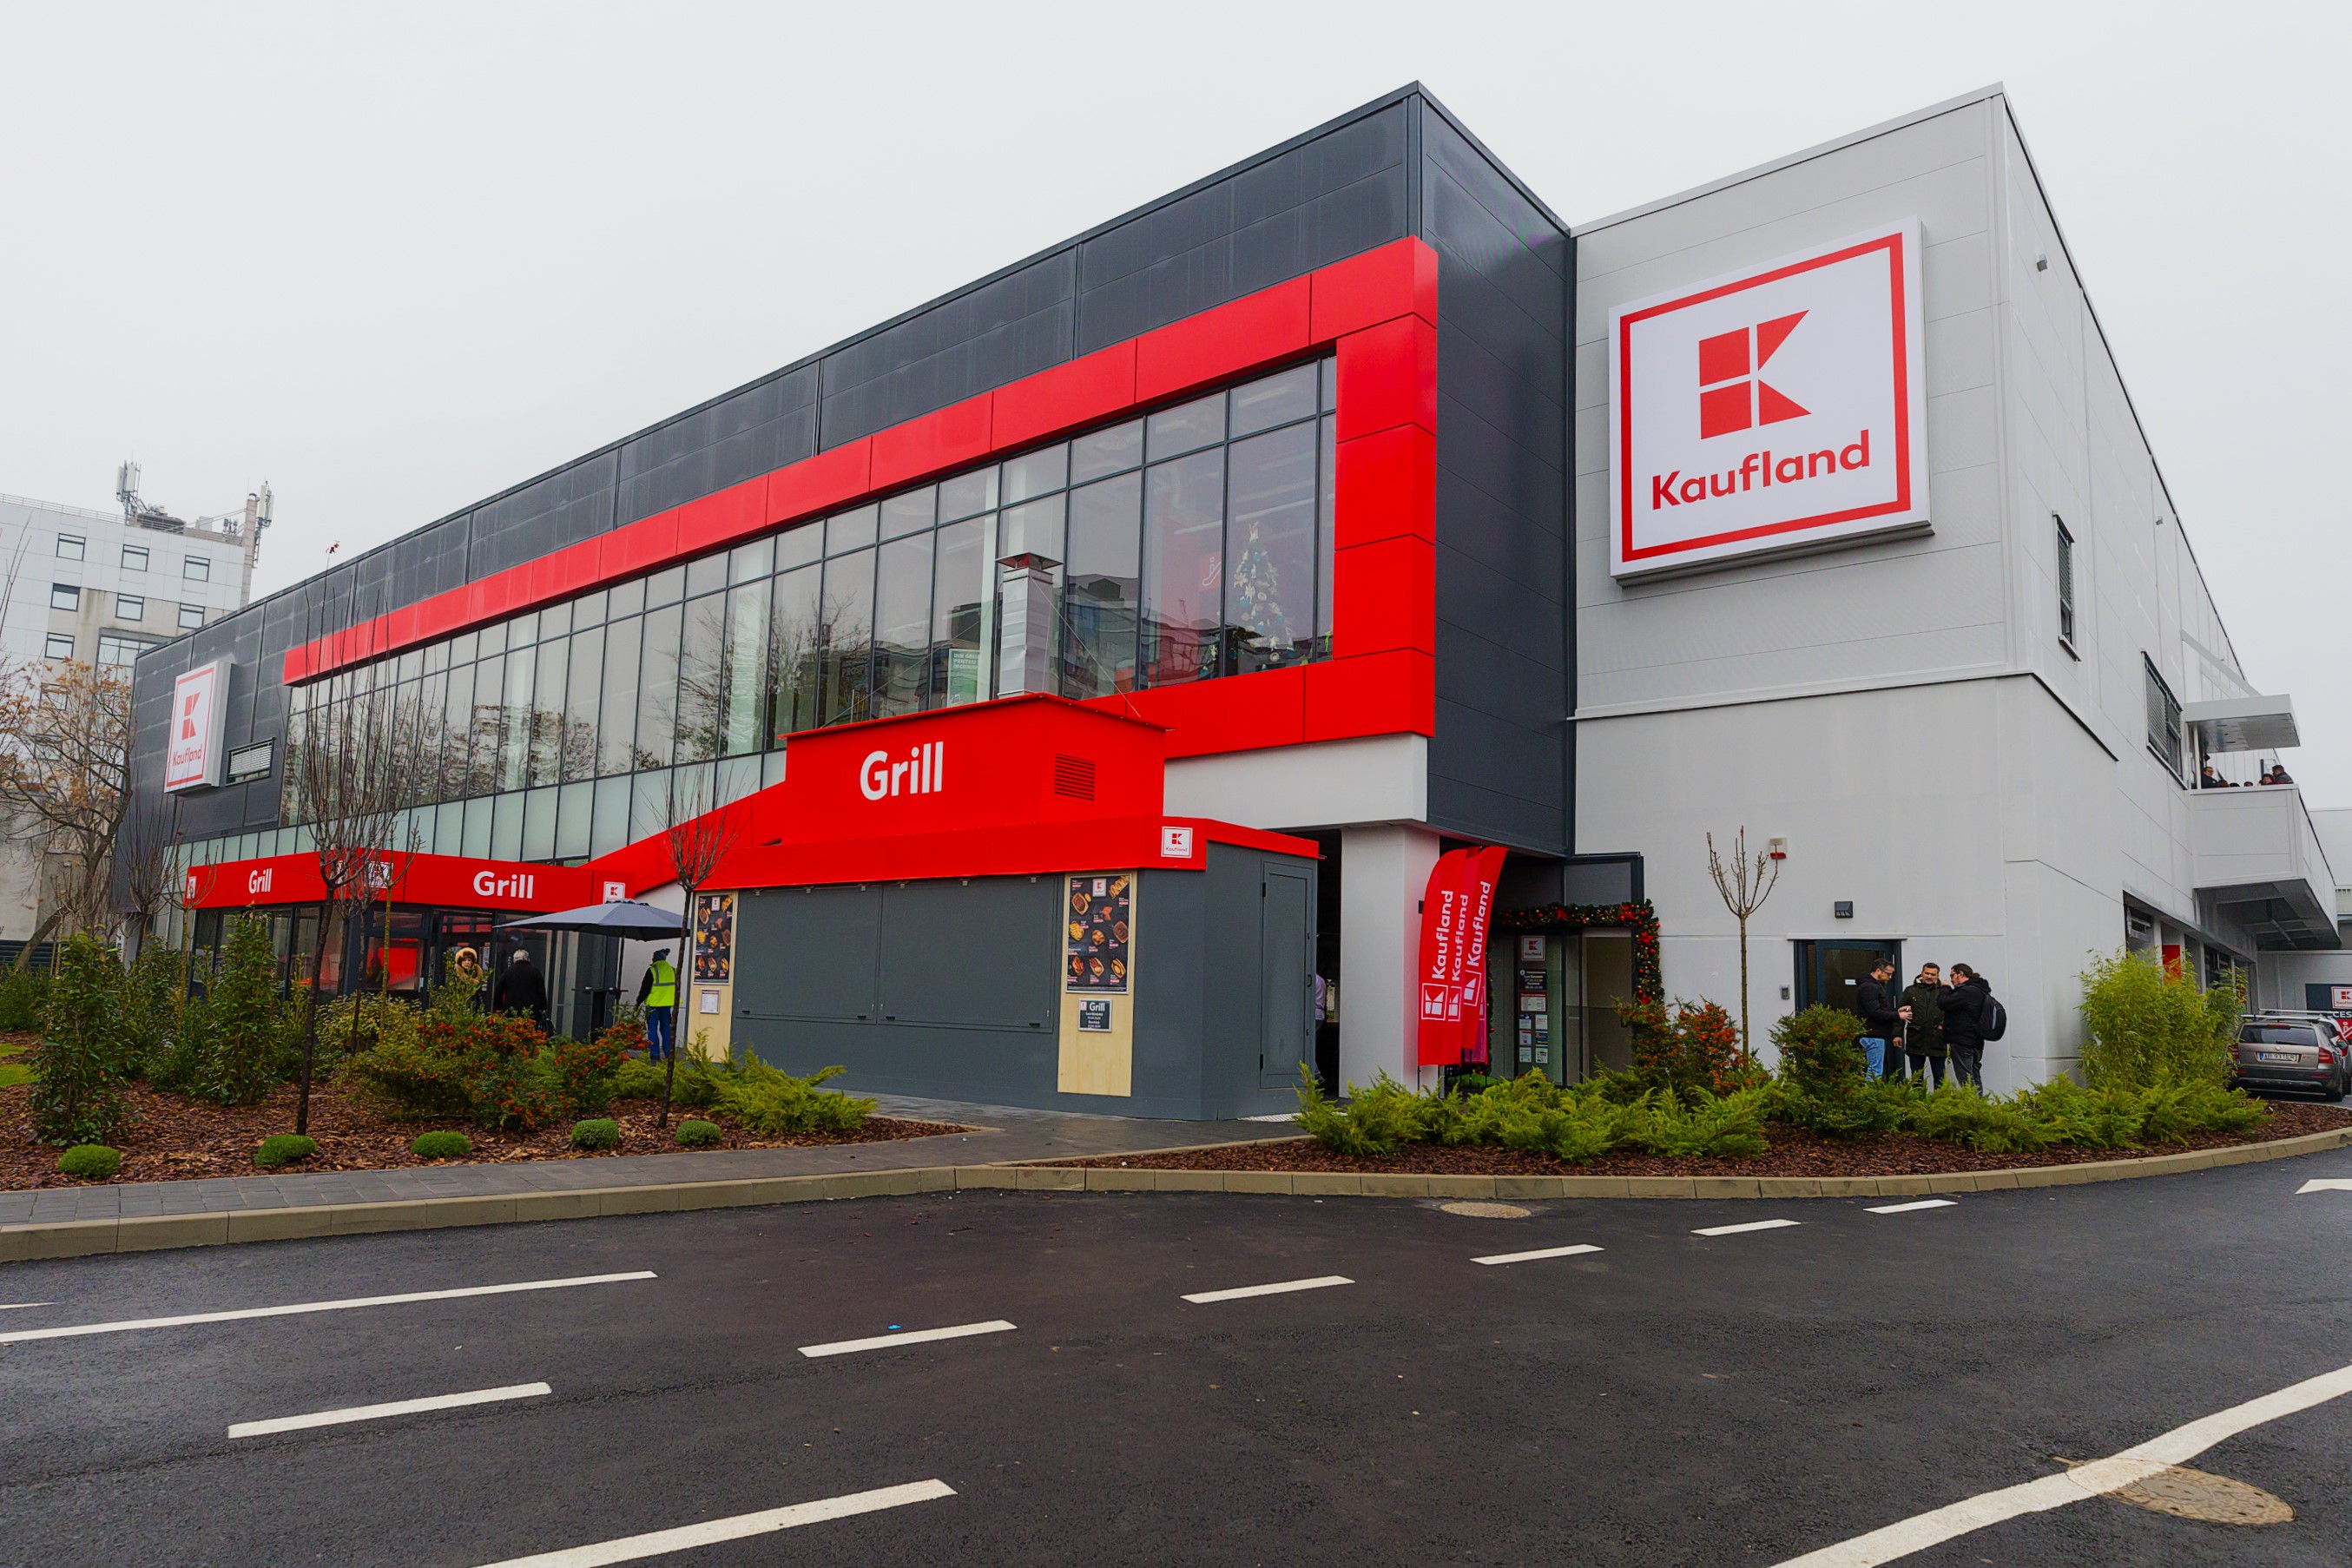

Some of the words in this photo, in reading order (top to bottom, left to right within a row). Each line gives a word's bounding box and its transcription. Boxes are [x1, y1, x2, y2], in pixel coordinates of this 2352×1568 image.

[1652, 429, 1870, 511] Kaufland
[173, 743, 202, 767] Kaufland
[860, 741, 944, 800] Grill
[248, 867, 273, 894] Grill
[473, 871, 534, 899] Grill
[1431, 890, 1454, 979] Kaufland
[1452, 894, 1469, 982] Kaufland
[1466, 880, 1492, 967] Kaufland
[1089, 1002, 1105, 1011] Grill
